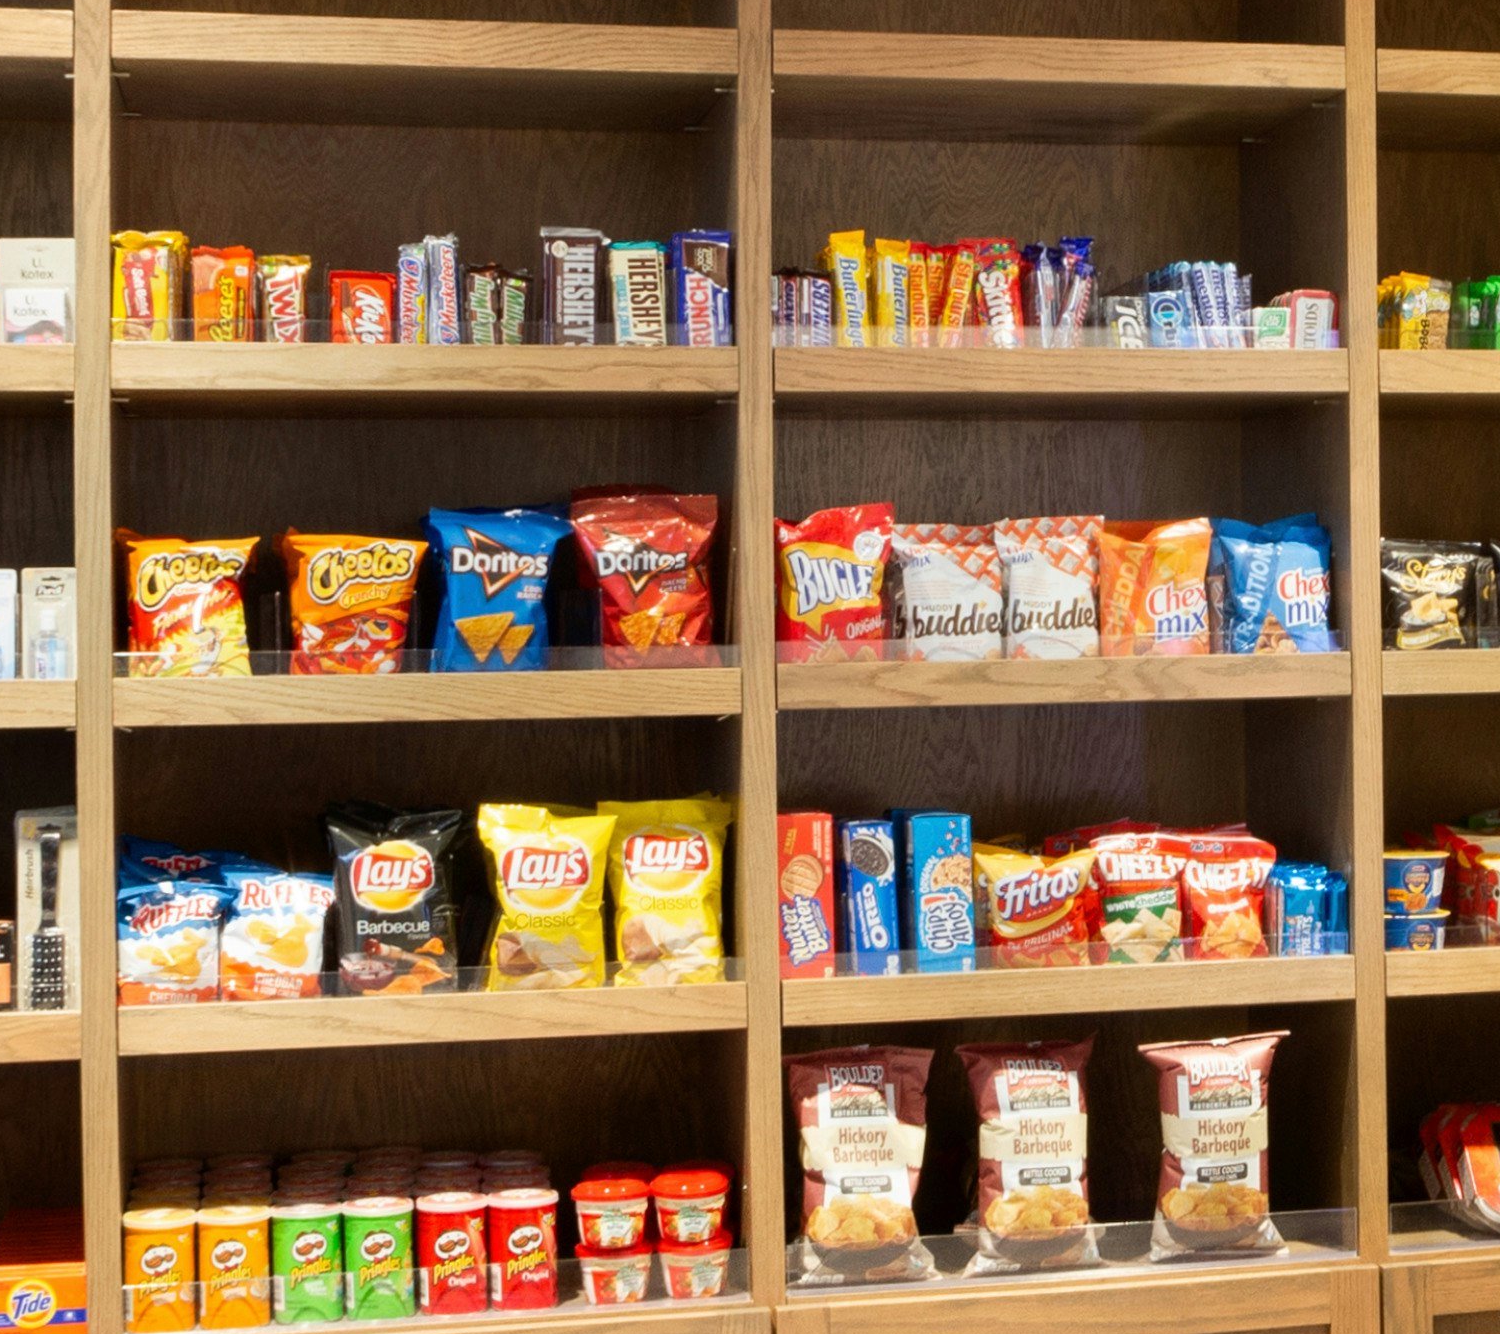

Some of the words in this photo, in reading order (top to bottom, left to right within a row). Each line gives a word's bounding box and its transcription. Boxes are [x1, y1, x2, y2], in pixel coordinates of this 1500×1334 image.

[20, 269, 54, 280] kotex
[438, 246, 457, 330] Musketeers
[13, 307, 48, 318] kotex
[267, 275, 300, 343] TWIX
[627, 257, 664, 344] HERSHEY'
[1193, 269, 1216, 327] mentos
[310, 542, 414, 604] Cheetos
[452, 547, 548, 577] Doritos
[597, 550, 688, 576] Doritos
[1399, 559, 1467, 593] Stacy's
[139, 552, 243, 611] Cheetos
[787, 549, 877, 617] BUGLE
[1277, 567, 1330, 601] Chex
[339, 585, 392, 609] Crunchy
[1147, 578, 1207, 616] Chex
[1286, 597, 1329, 627] mix
[1156, 610, 1207, 640] mix
[508, 846, 585, 890] Lay's
[627, 836, 705, 874] Lay's
[24, 848, 35, 900] Hairbrush
[358, 853, 430, 892] Lay's
[638, 895, 699, 912] Classic
[995, 865, 1080, 920] Fritos
[132, 897, 217, 933] RUFFLES
[357, 919, 430, 936] Barbecue
[515, 912, 577, 930] Classic
[862, 882, 890, 949] OREO
[927, 900, 956, 952] Chips
[830, 1065, 885, 1093] BOULDER
[1007, 1059, 1066, 1085] BOULDER
[1188, 1056, 1250, 1086] BOULDER
[838, 1128, 888, 1148] Hickory
[1019, 1119, 1066, 1137] Hickory
[1198, 1120, 1247, 1138] Hickory
[832, 1148, 895, 1166] Barbeque
[1013, 1137, 1073, 1156] Barbeque
[1191, 1136, 1252, 1157] Barbeque
[210, 1265, 252, 1295] Pringles
[290, 1257, 332, 1289] Pringles
[359, 1256, 401, 1289] Pringles
[433, 1255, 476, 1286] Pringles
[506, 1250, 548, 1281] Pringles
[139, 1270, 182, 1299] Pringles
[12, 1292, 52, 1321] Tide
